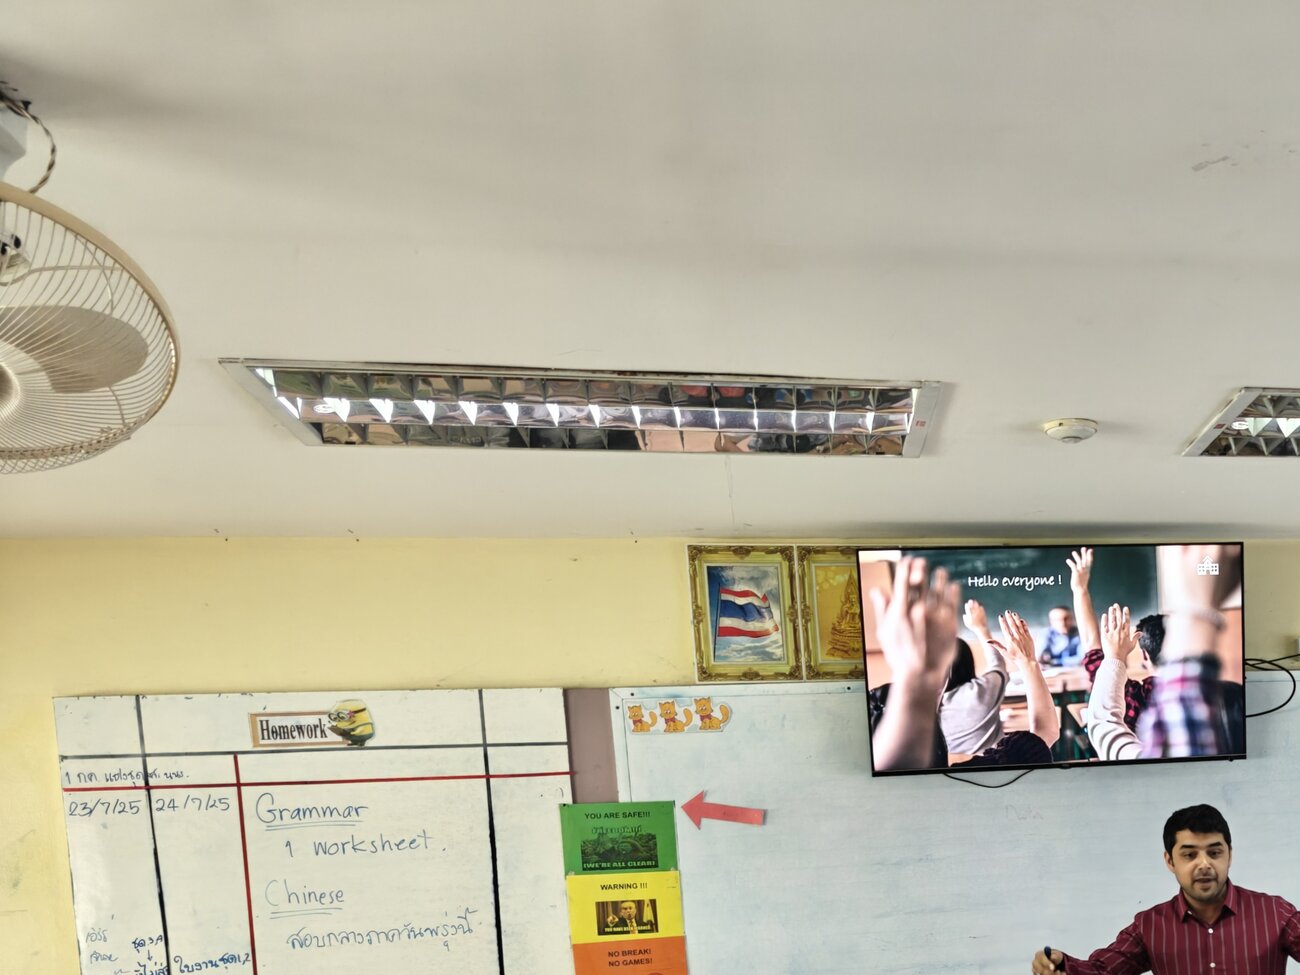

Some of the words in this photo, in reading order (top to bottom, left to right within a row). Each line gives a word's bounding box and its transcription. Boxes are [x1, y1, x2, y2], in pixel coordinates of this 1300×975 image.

[968, 575, 999, 587] Hello
[1002, 576, 1055, 591] everyone
[259, 718, 328, 740] Homework
[69, 798, 142, 817] 23/7/25
[256, 792, 368, 823] Grammar
[265, 879, 344, 906] Chinese
[286, 907, 478, 952] สอบกลางภาควันพรุ่งนี้
[622, 948, 651, 956] BREAK!
[622, 958, 653, 966] GAMES!
